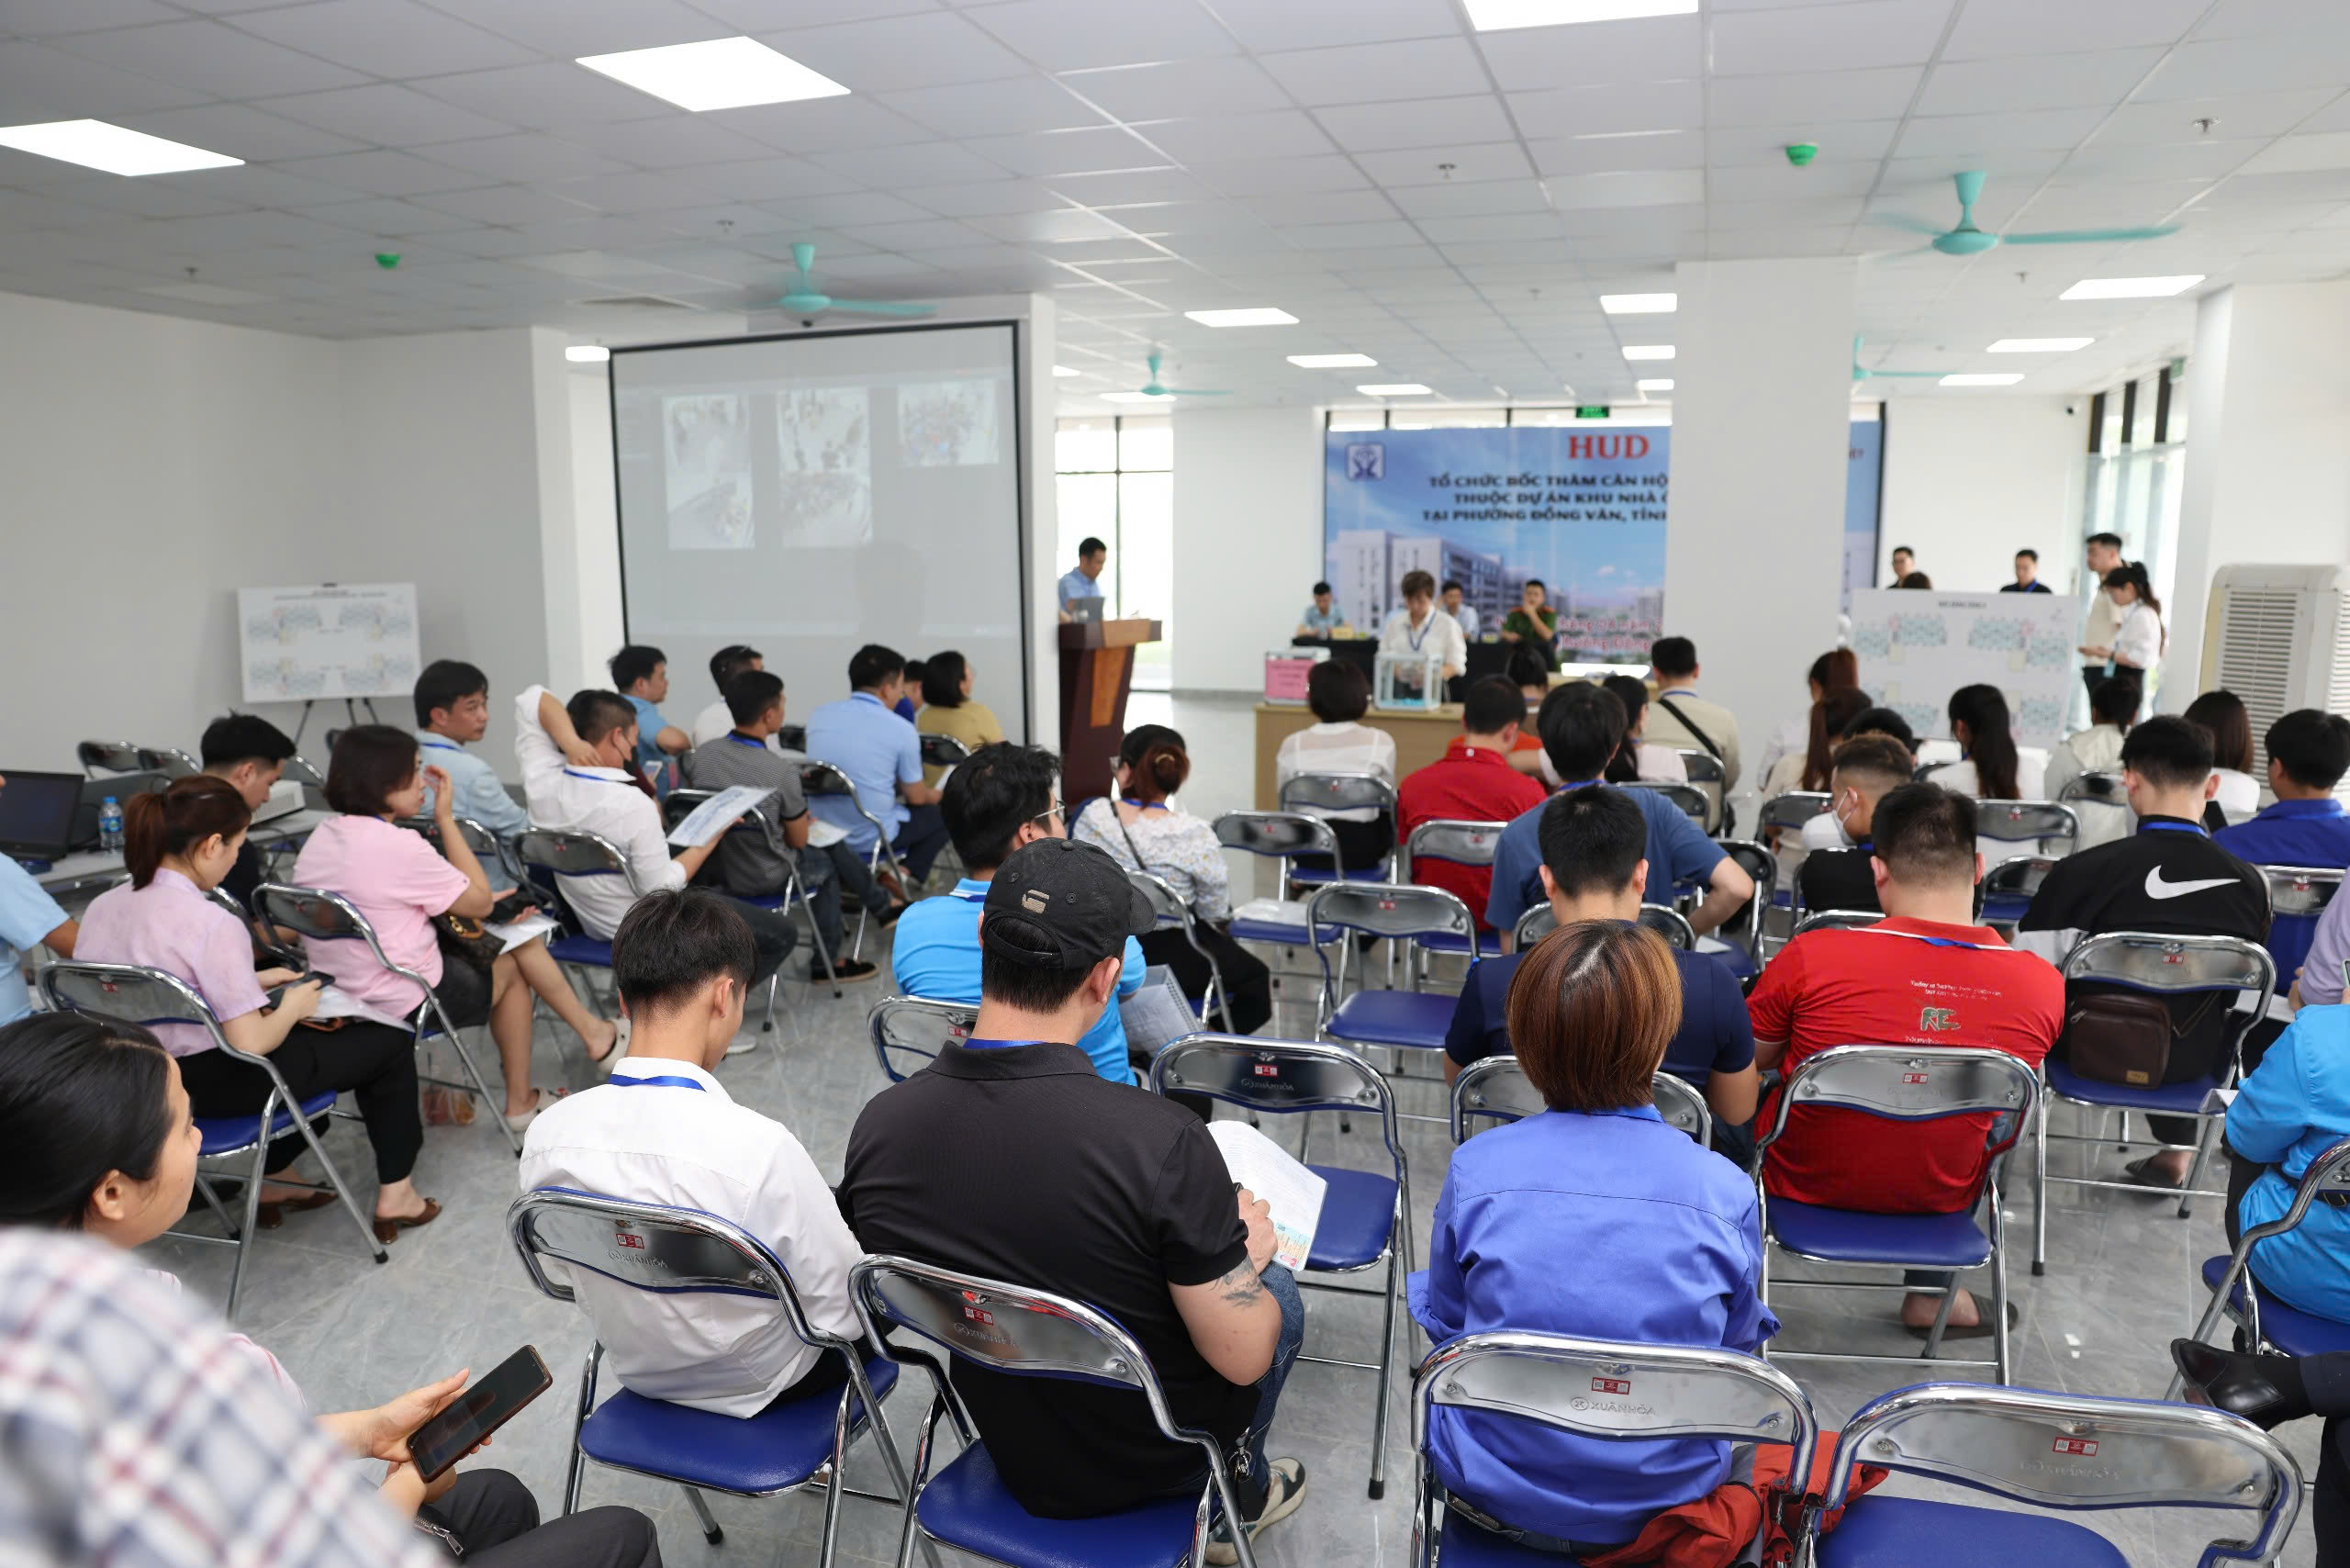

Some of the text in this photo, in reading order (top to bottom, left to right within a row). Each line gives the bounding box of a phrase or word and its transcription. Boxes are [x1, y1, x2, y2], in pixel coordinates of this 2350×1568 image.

[1568, 435, 1651, 459] HUD
[1506, 472, 1539, 487] BỐC
[1455, 490, 1510, 506] THUỘC
[1575, 492, 1613, 504] KHU
